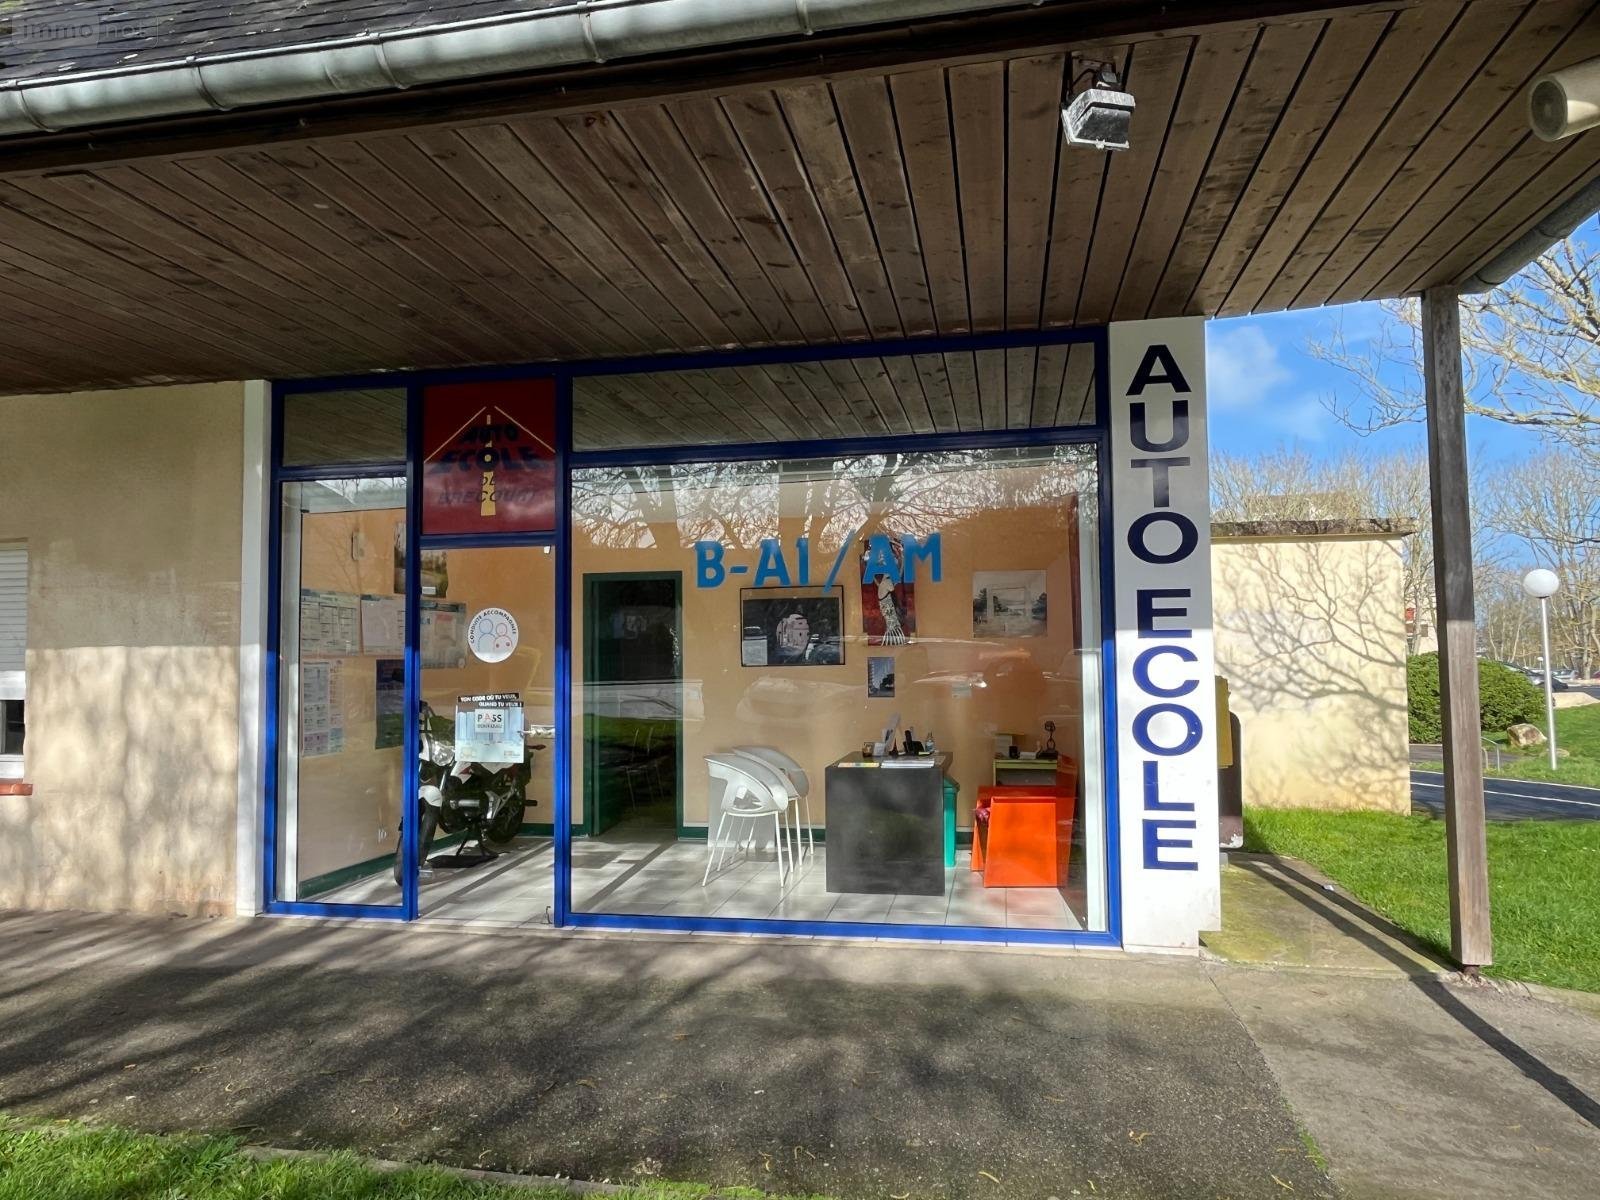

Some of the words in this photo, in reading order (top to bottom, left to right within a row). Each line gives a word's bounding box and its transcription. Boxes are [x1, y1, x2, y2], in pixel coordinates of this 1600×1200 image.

[1125, 344, 1199, 565] AUTO
[861, 531, 943, 584] AM
[477, 713, 502, 723] PASS
[1131, 587, 1204, 872] ECOLE
